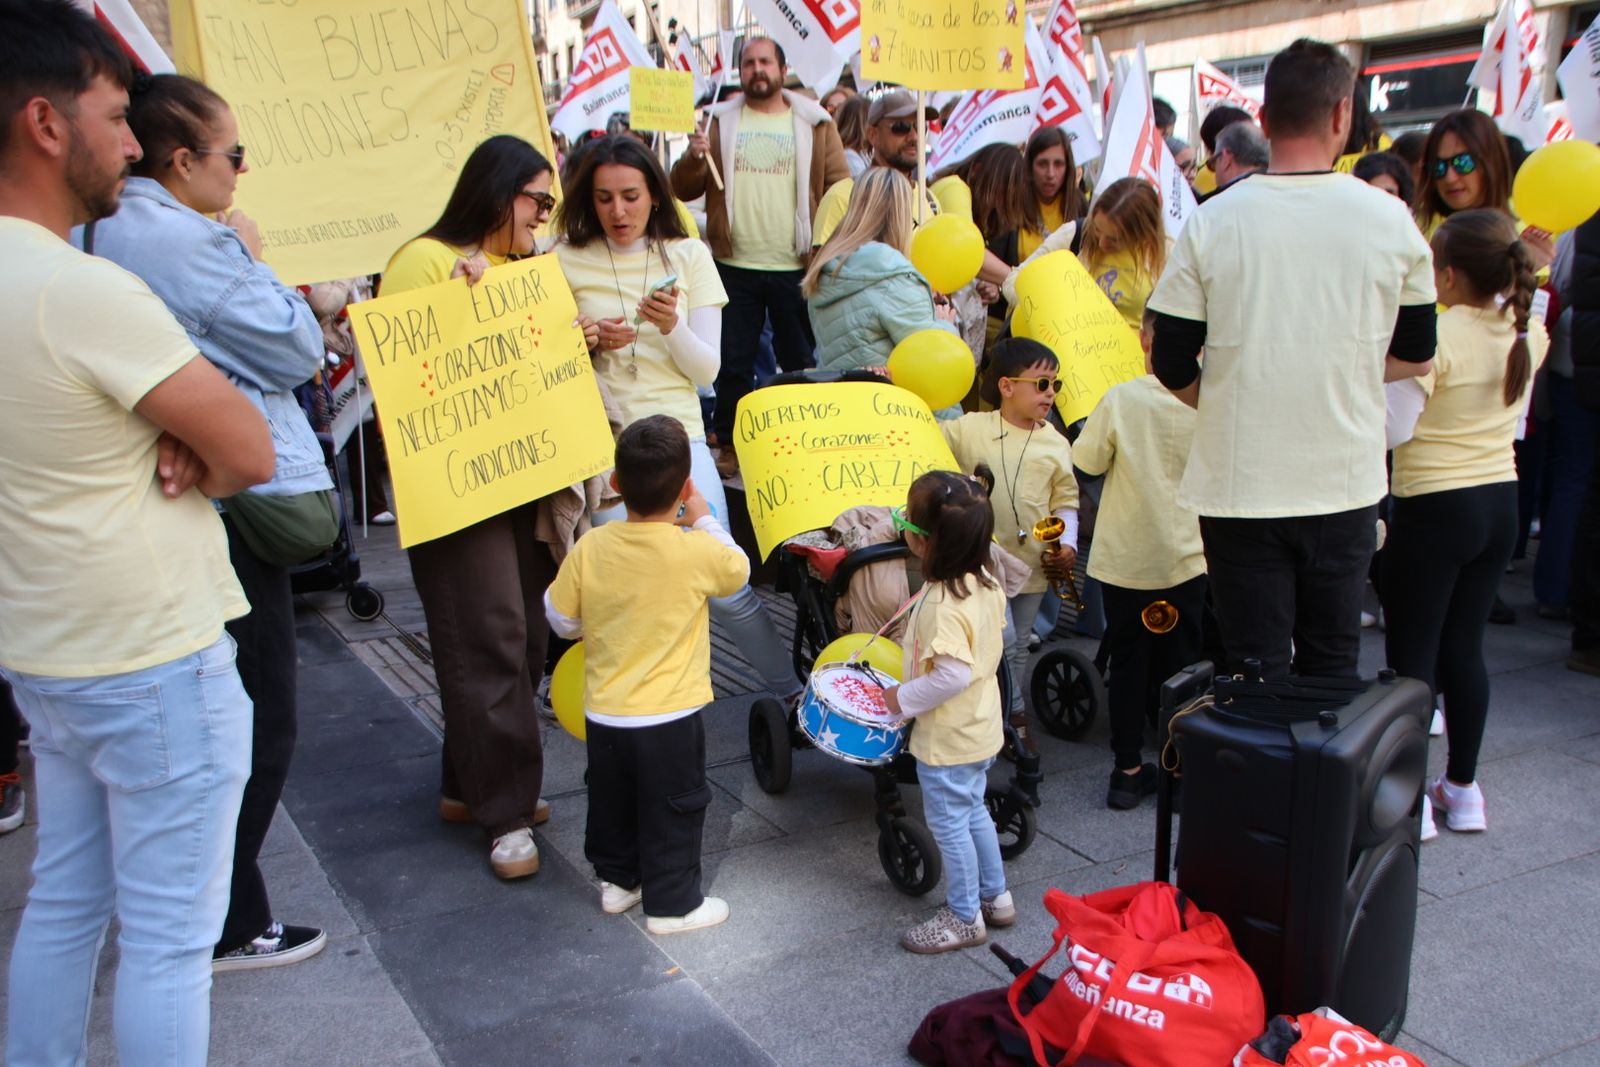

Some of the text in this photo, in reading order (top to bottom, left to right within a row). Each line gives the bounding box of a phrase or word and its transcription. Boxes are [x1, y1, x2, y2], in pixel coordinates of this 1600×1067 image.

[943, 2, 961, 29] de
[205, 0, 499, 85] TAN BUENAS
[885, 28, 898, 61] 7
[365, 268, 549, 367] PARA EDUCAR
[433, 324, 533, 391] CORAZONES
[396, 356, 584, 457] NECESITAMOS buenas
[740, 401, 841, 443] QUEREMOS
[801, 431, 885, 450] Corazones
[756, 475, 788, 520] NO
